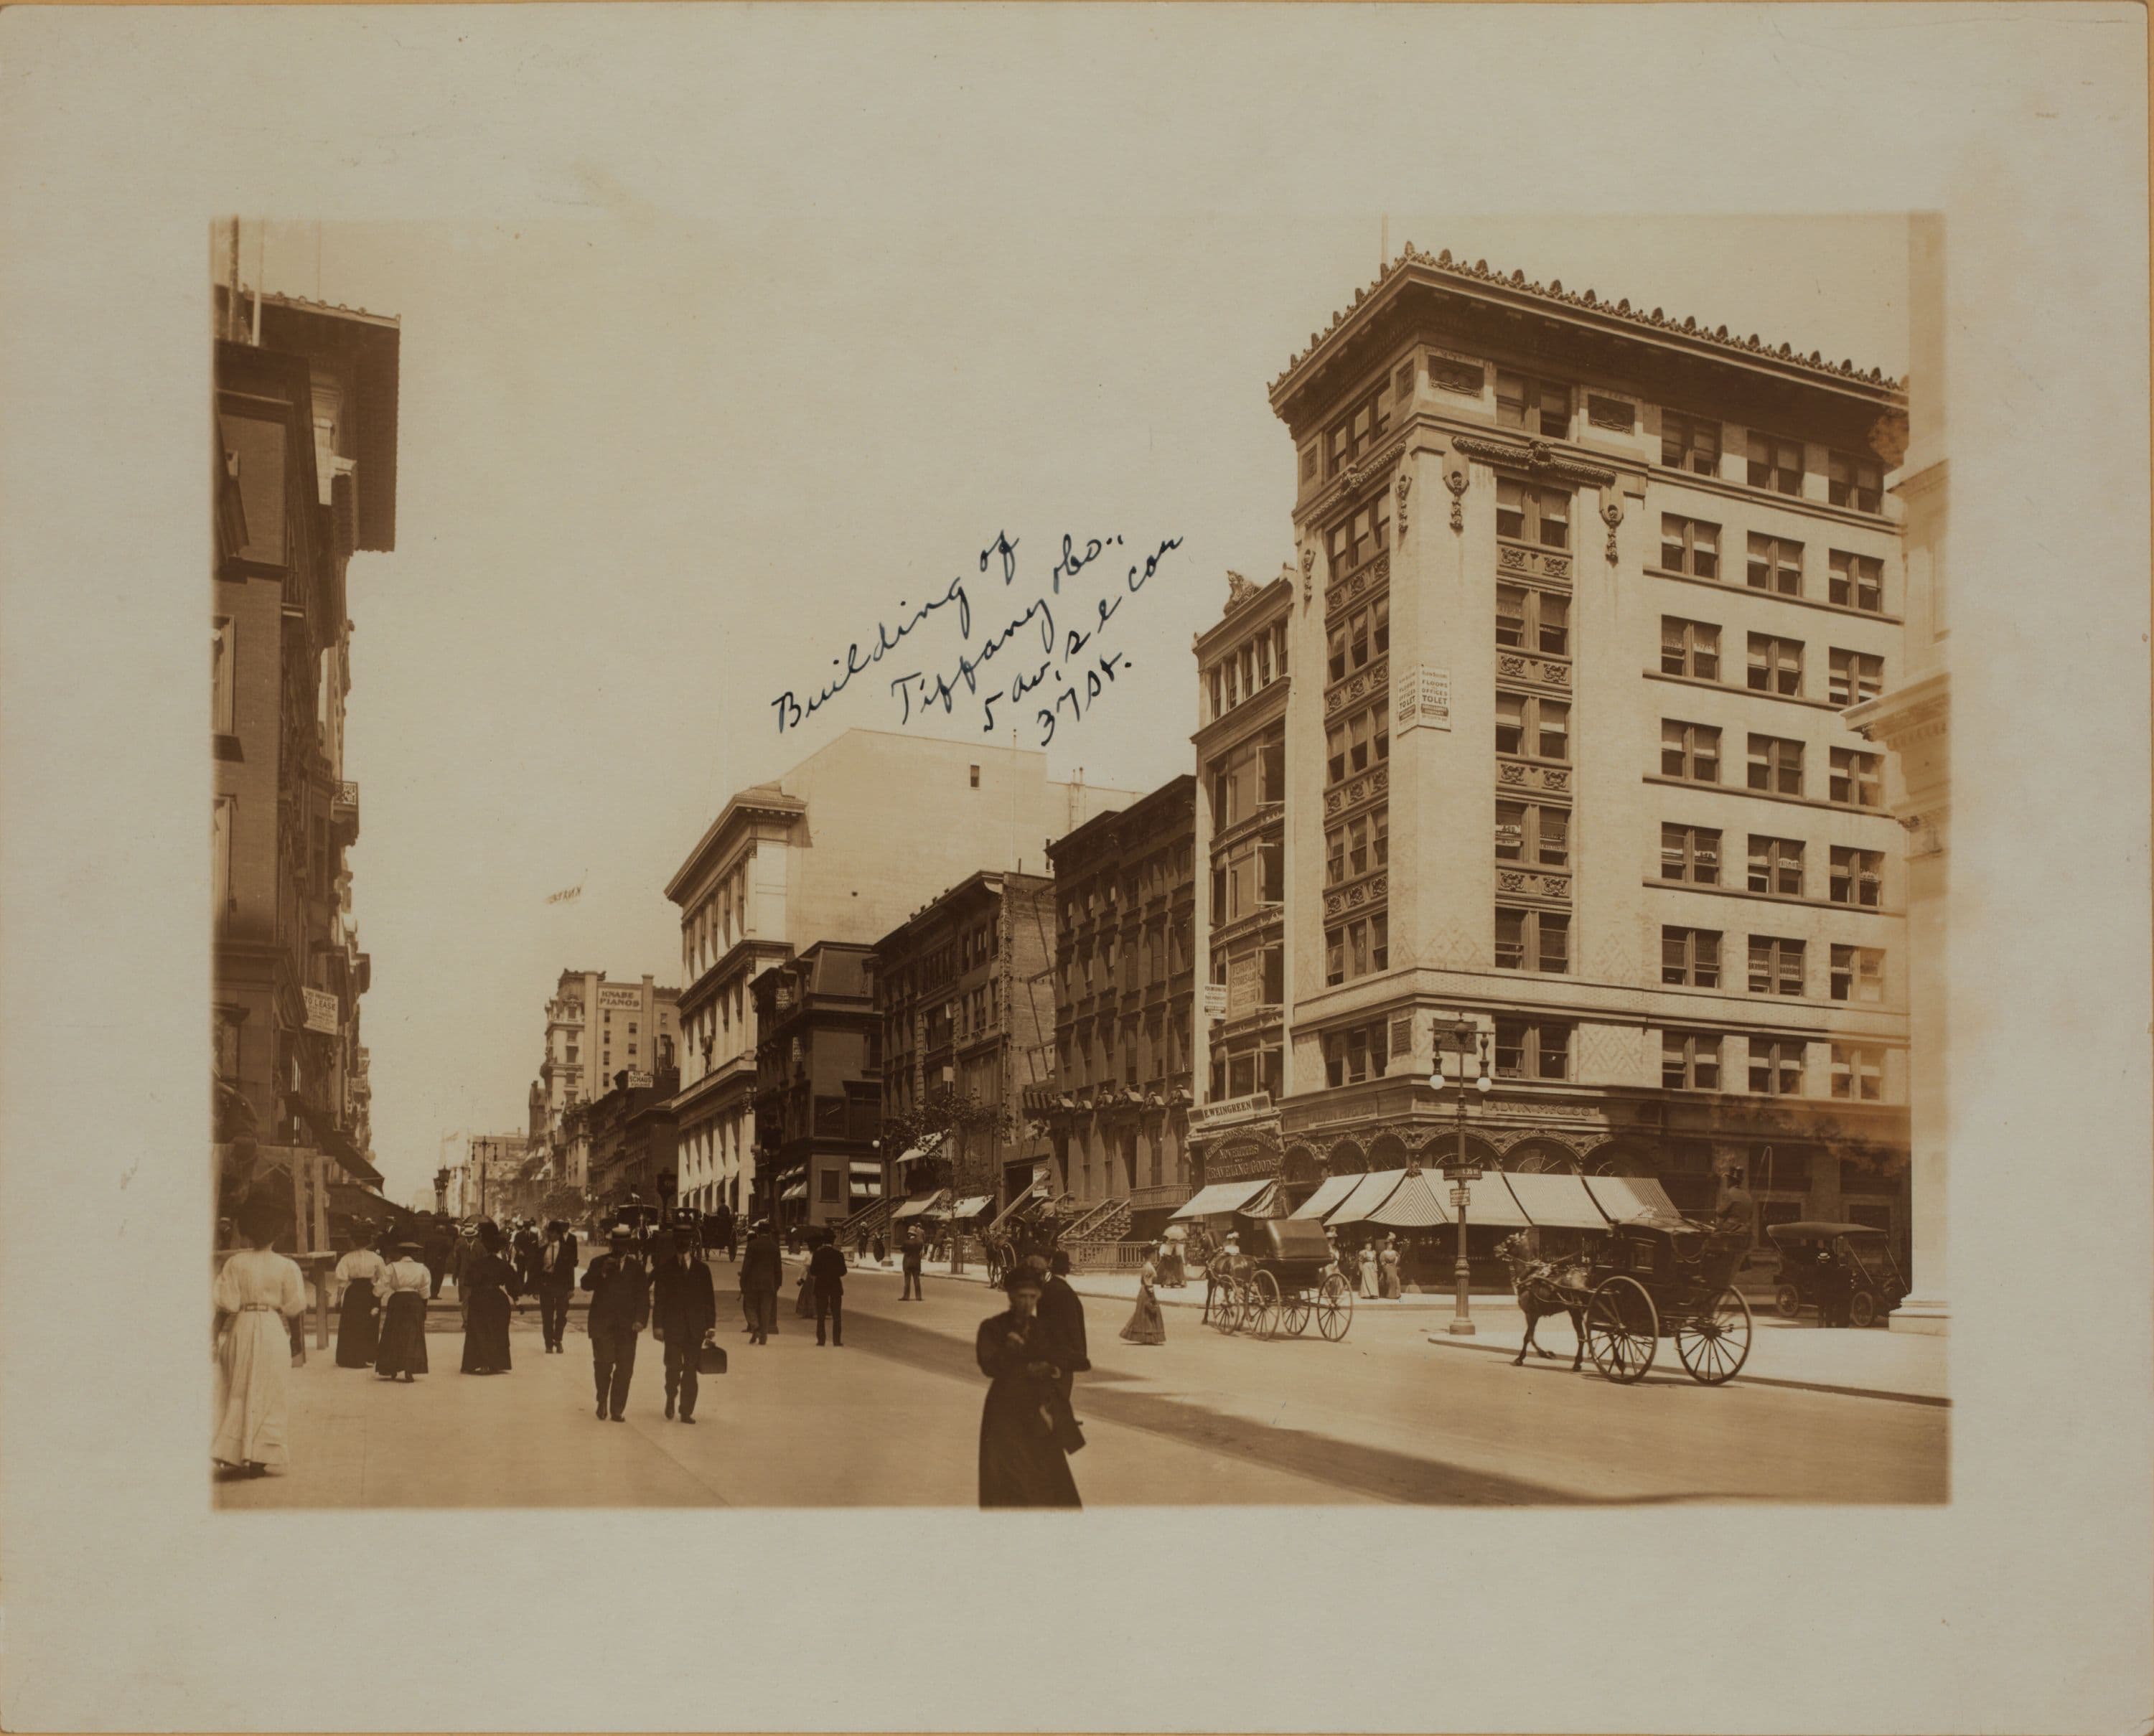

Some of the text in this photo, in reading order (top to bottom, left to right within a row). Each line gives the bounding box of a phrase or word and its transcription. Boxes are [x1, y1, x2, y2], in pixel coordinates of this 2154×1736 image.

[772, 529, 1019, 733] Building of
[984, 692, 1003, 732] 5
[314, 998, 336, 1011] LEASE
[599, 998, 640, 1008] PIANOS
[1490, 1101, 1532, 1114] ALVIN
[1205, 1158, 1276, 1179] TRAVELING GOODS
